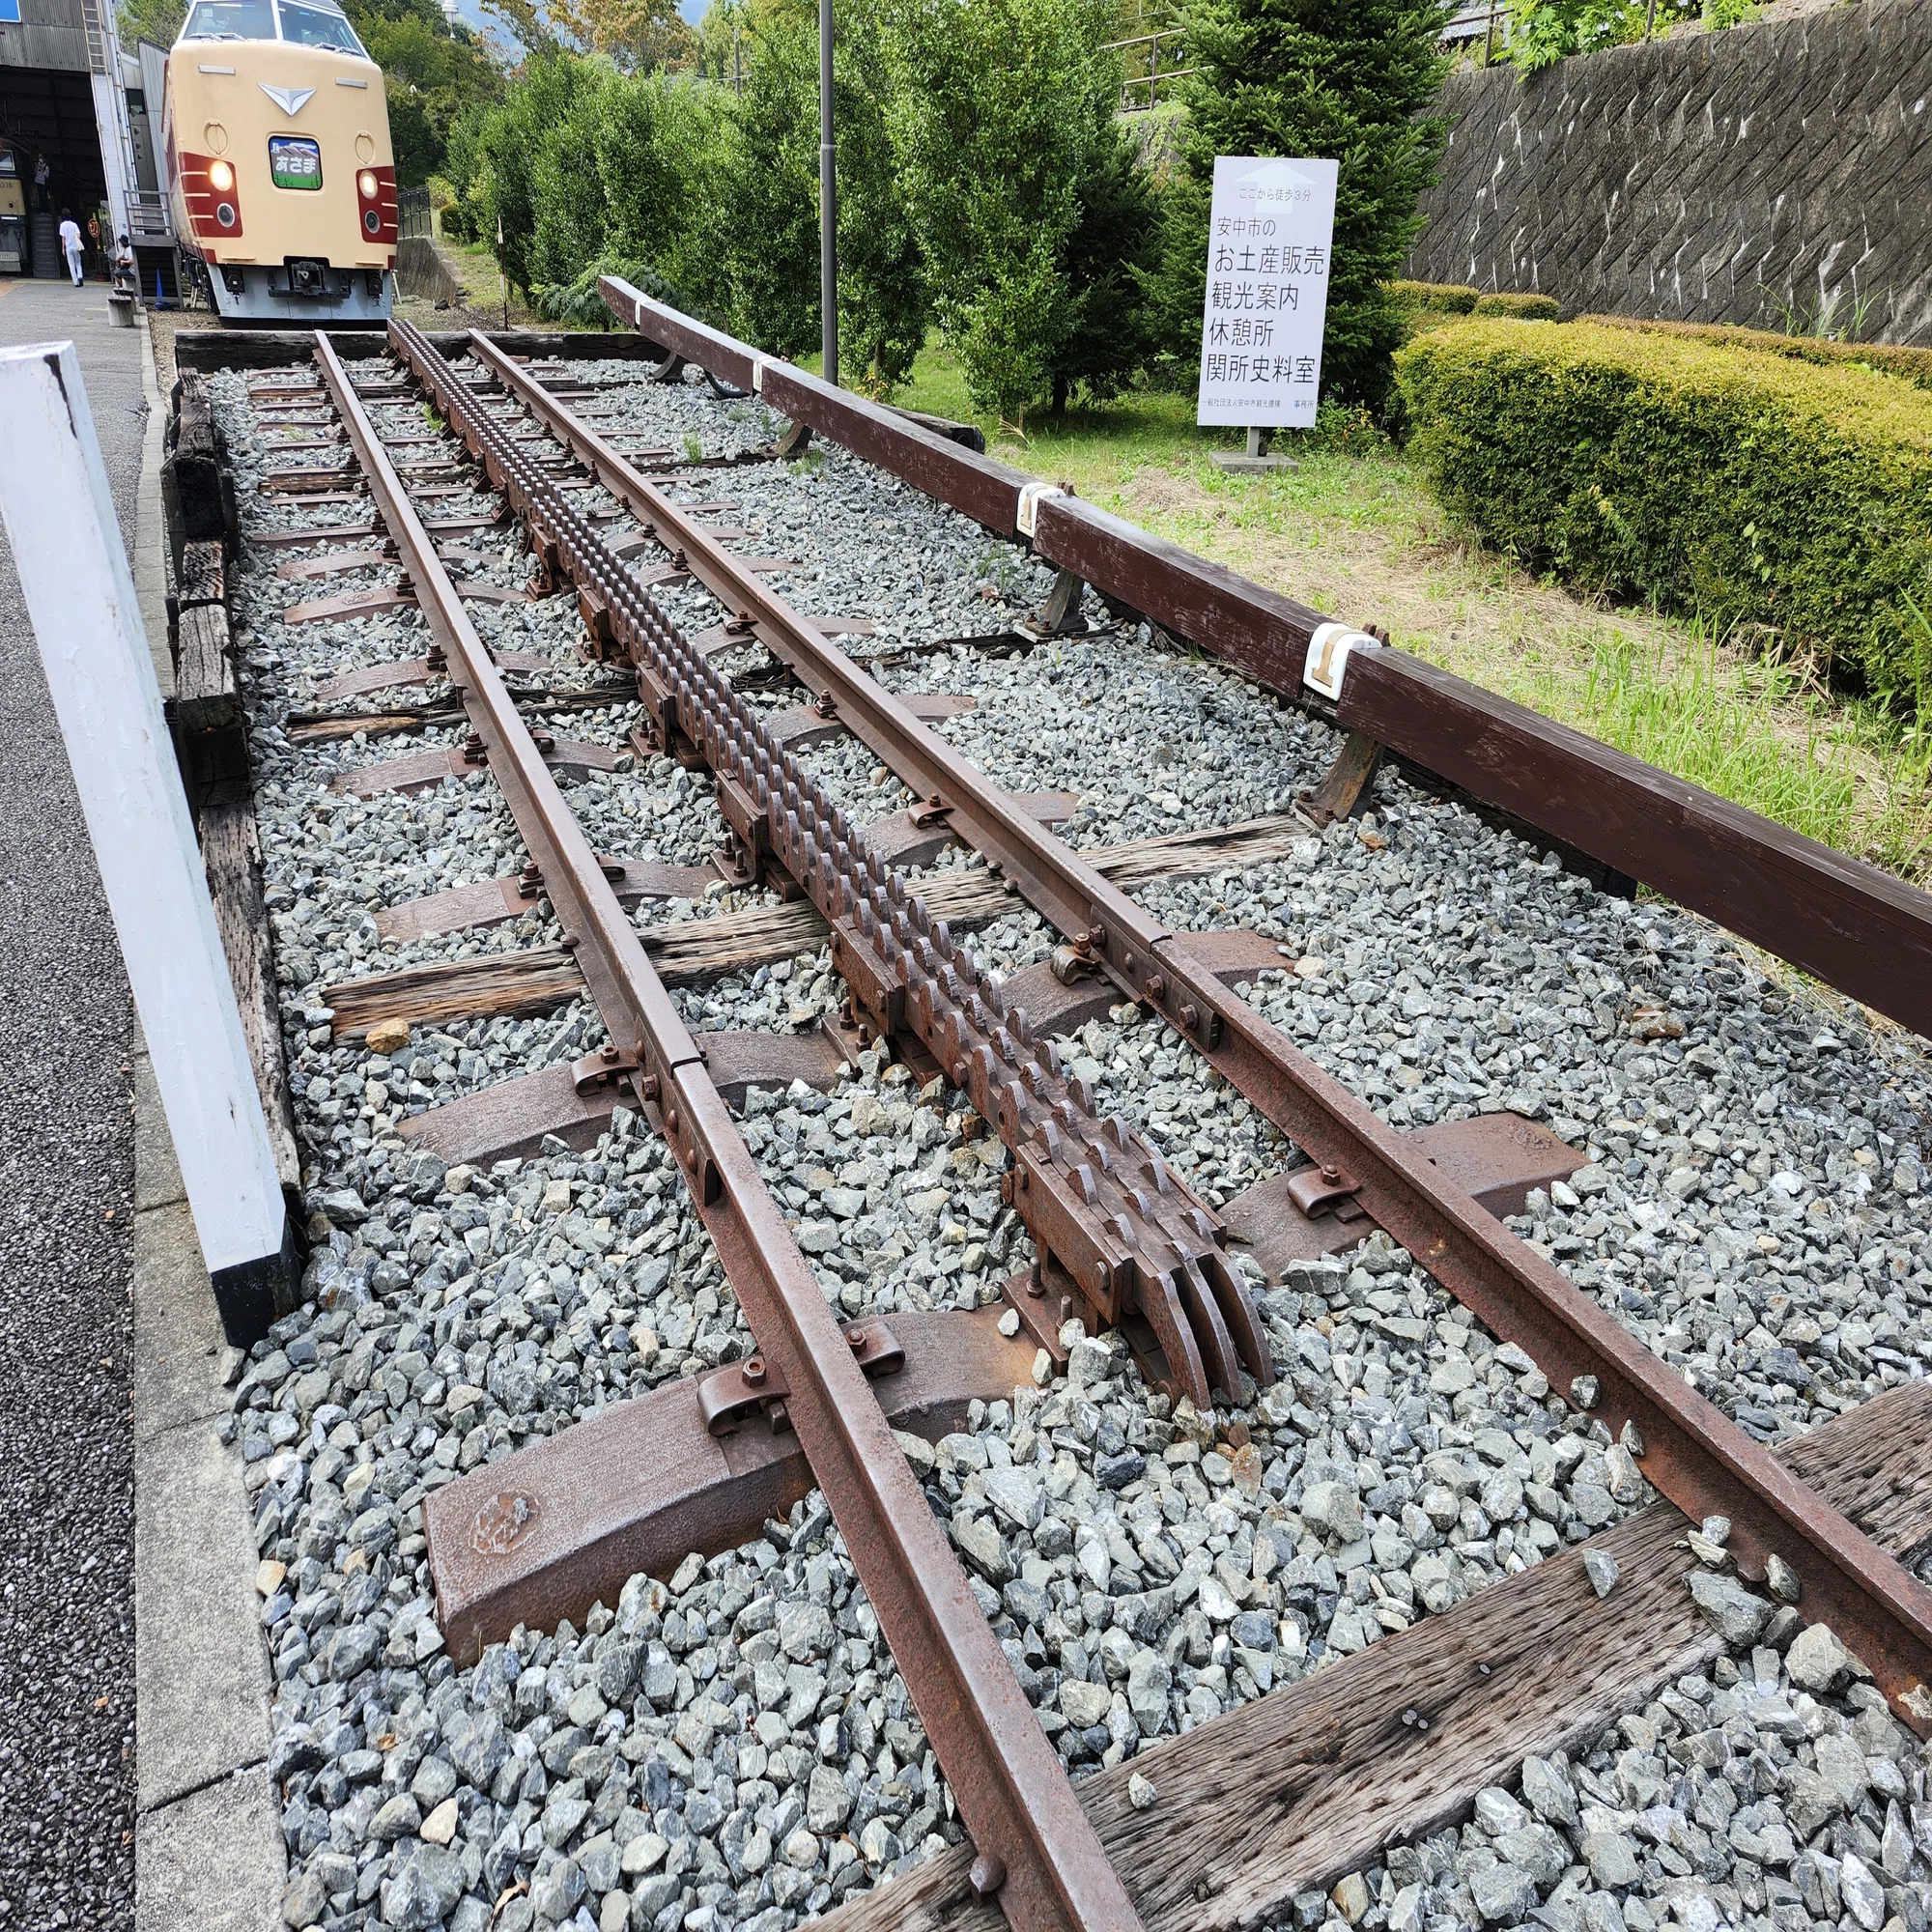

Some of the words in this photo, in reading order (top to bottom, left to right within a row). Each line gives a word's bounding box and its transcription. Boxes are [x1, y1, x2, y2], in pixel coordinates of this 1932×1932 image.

[276, 156, 316, 174] あさま
[1239, 187, 1312, 202] ここから徒歩3分
[1217, 216, 1276, 238] 安中市の
[1214, 243, 1324, 274] お土産販売
[1211, 280, 1299, 311] 観光案内
[1209, 317, 1274, 347] 休憩所
[1207, 354, 1315, 384] 関所史料室
